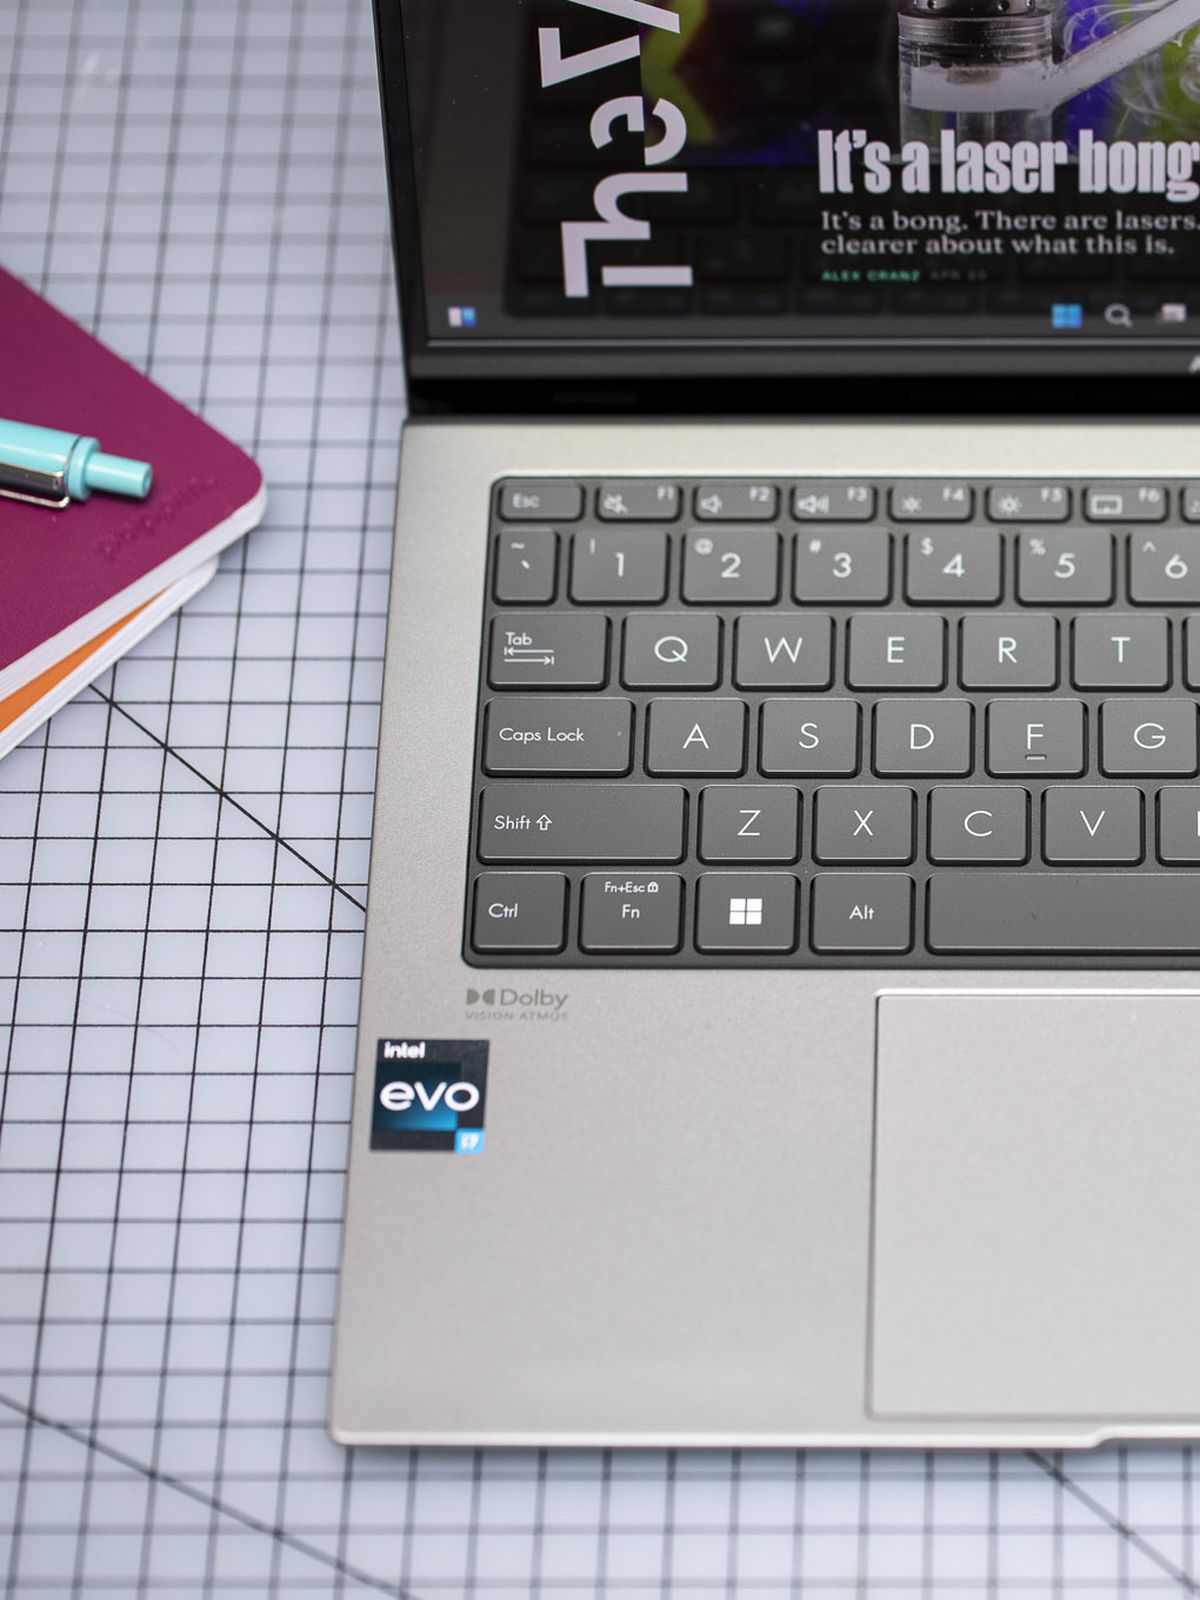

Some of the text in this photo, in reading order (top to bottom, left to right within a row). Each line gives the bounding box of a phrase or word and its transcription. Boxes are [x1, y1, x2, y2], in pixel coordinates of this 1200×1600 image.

[818, 129, 1200, 202] It's a laser bong
[822, 211, 861, 230] It's
[870, 216, 884, 230] a
[893, 210, 968, 234] bong.
[975, 210, 1056, 230] There
[1064, 216, 1107, 230] are
[822, 234, 1174, 254] clearer about what this is.
[513, 494, 539, 508] Esc
[616, 553, 624, 576] 1
[722, 553, 740, 577] 2
[833, 553, 851, 577] 3
[944, 554, 964, 577] 4
[1055, 553, 1075, 578] 5
[1165, 555, 1187, 578] 6
[506, 632, 532, 645] Tab
[655, 636, 688, 662] Q
[765, 638, 802, 663] W
[888, 637, 904, 663] E
[999, 637, 1016, 663] R
[1111, 637, 1130, 662] T
[500, 727, 584, 744] Caps Lock
[683, 724, 709, 749] A
[799, 723, 819, 748] S
[911, 724, 934, 749] D
[1028, 724, 1043, 749] F
[1134, 723, 1166, 749] G
[494, 815, 530, 829] Shift
[738, 810, 760, 835] Z
[853, 811, 873, 835] X
[965, 811, 992, 836] C
[1080, 811, 1105, 836] V
[605, 882, 645, 892] Fn+Esc
[489, 903, 517, 918] Ctrl
[622, 904, 639, 918] Fn
[849, 905, 874, 919] Alt
[500, 988, 568, 1009] Dolby
[384, 1042, 425, 1058] intel
[380, 1081, 480, 1111] evo
